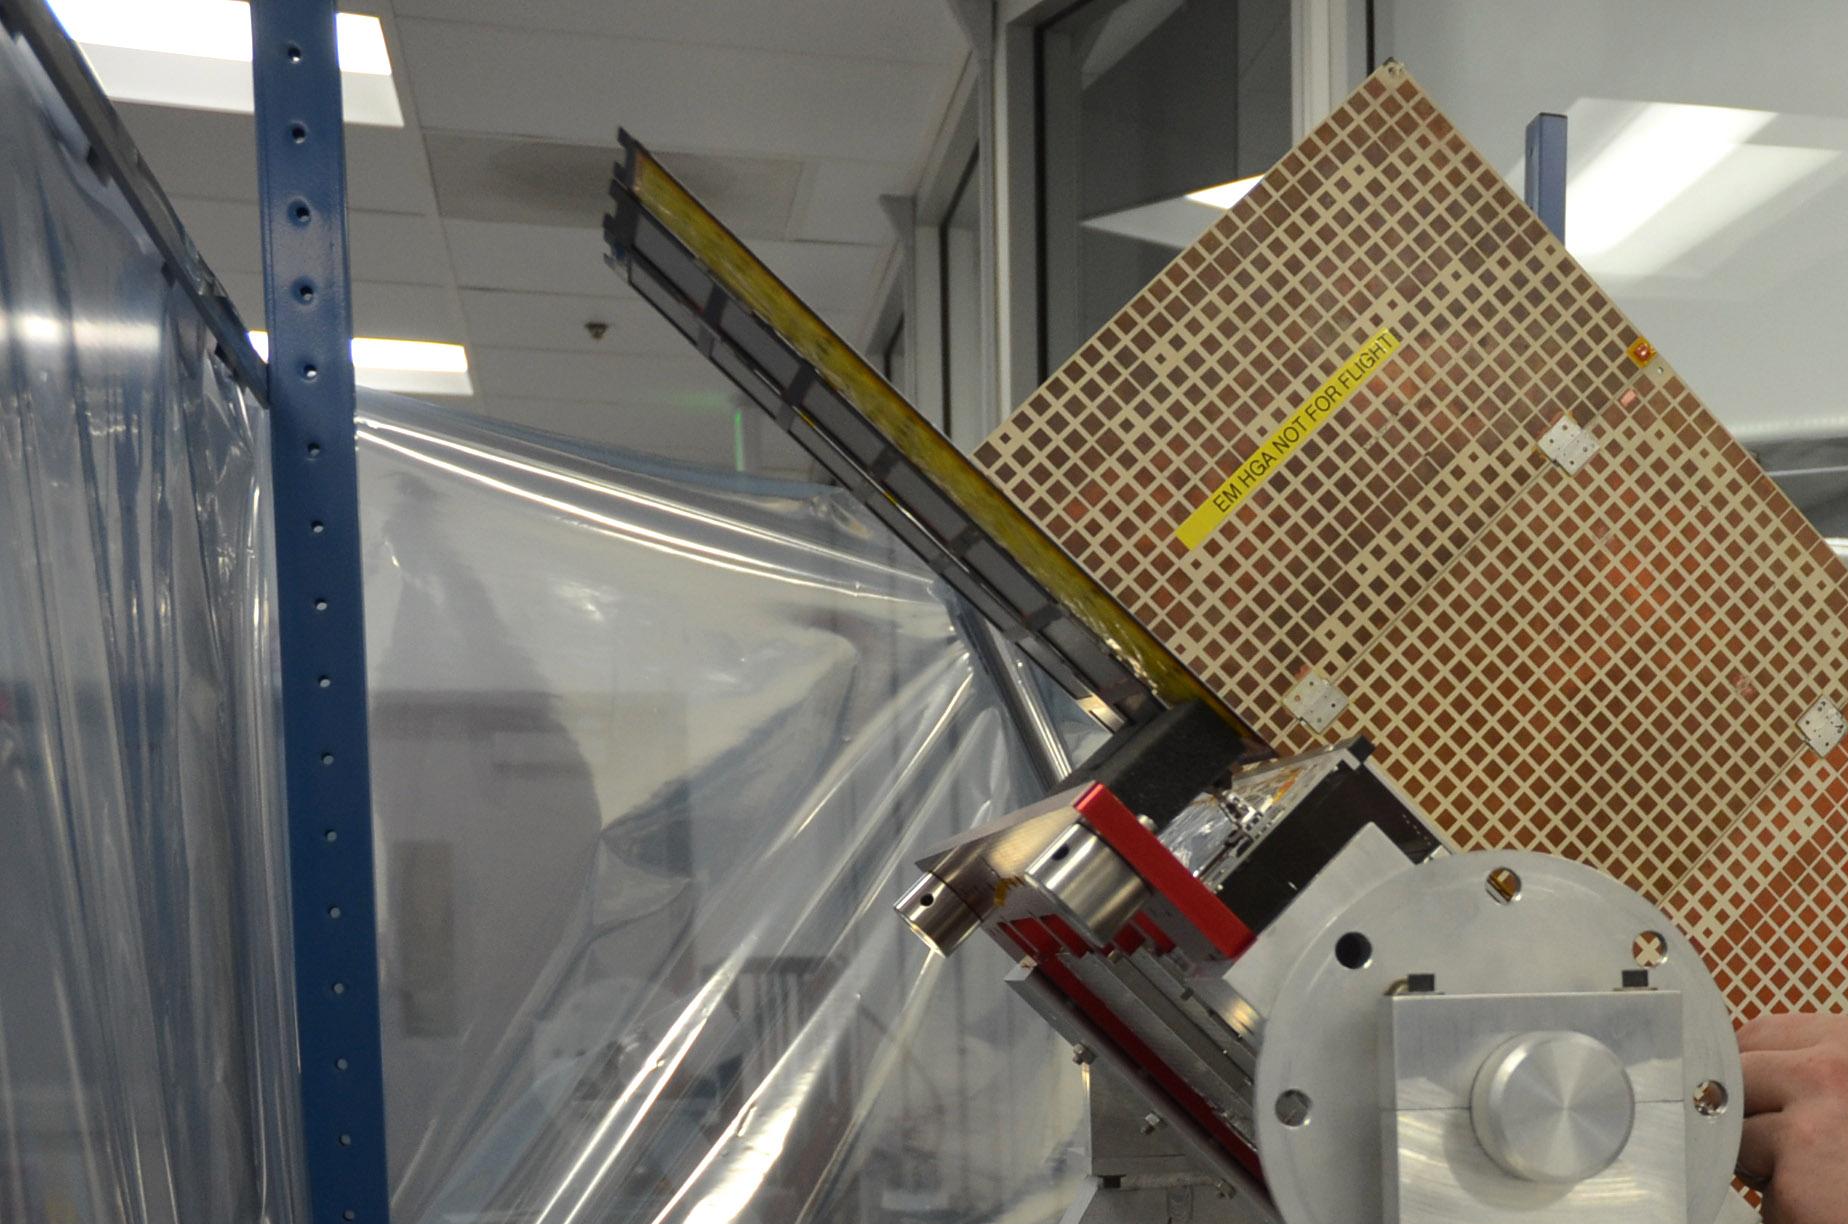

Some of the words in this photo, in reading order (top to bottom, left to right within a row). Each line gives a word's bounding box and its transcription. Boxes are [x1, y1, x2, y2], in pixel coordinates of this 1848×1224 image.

[1213, 483, 1242, 512] EM
[1238, 452, 1277, 488] HGA
[1272, 416, 1307, 454] NOT
[1305, 385, 1342, 421] FOR
[1338, 335, 1393, 389] FLIGHT
